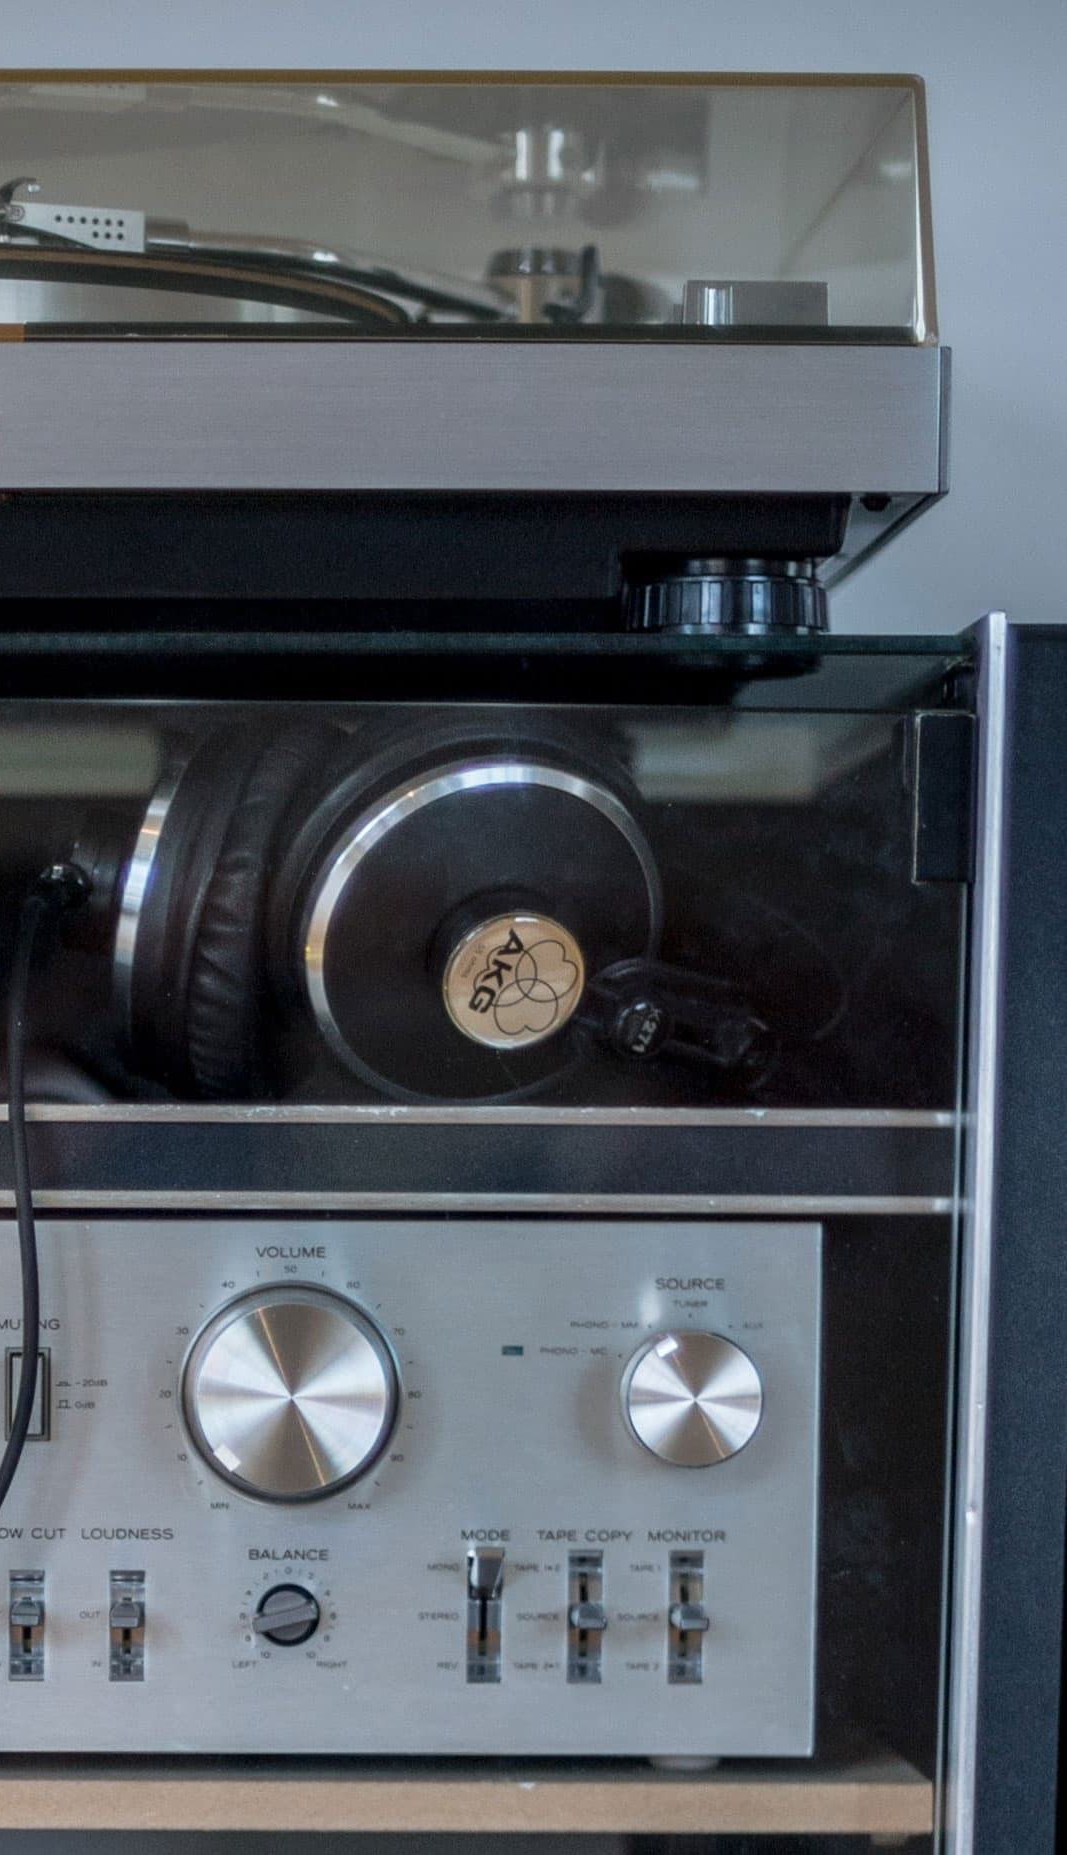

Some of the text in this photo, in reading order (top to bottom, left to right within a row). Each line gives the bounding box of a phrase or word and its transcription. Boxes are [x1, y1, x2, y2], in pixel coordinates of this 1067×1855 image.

[469, 928, 524, 1014] AKG
[255, 1246, 326, 1259] VOLUME
[284, 1265, 297, 1273] 50
[221, 1281, 236, 1289] 40
[655, 1278, 725, 1291] SOURCE
[673, 1300, 708, 1308] TUNER
[570, 1321, 639, 1329] PHONO MM
[540, 1347, 580, 1355] PHONO
[159, 1390, 171, 1398] 20
[31, 1527, 67, 1540] CUT
[81, 1527, 175, 1540] LOUDNESS
[460, 1529, 511, 1542] MODE
[537, 1529, 632, 1542] TAPE COPY
[647, 1529, 727, 1542] MONITOR
[248, 1548, 330, 1561] BALANCE
[427, 1563, 460, 1572] MONO
[515, 1563, 539, 1572] TAPE
[630, 1563, 654, 1572] TAPE
[79, 1611, 101, 1619] OUT
[418, 1612, 460, 1621] STEREO
[516, 1612, 560, 1622] SOURCE
[617, 1612, 660, 1621] SOURCE
[232, 1661, 257, 1669] LEFT
[316, 1660, 347, 1669] RIGHT
[513, 1662, 538, 1670] TAPE
[626, 1662, 650, 1671] TAPE
